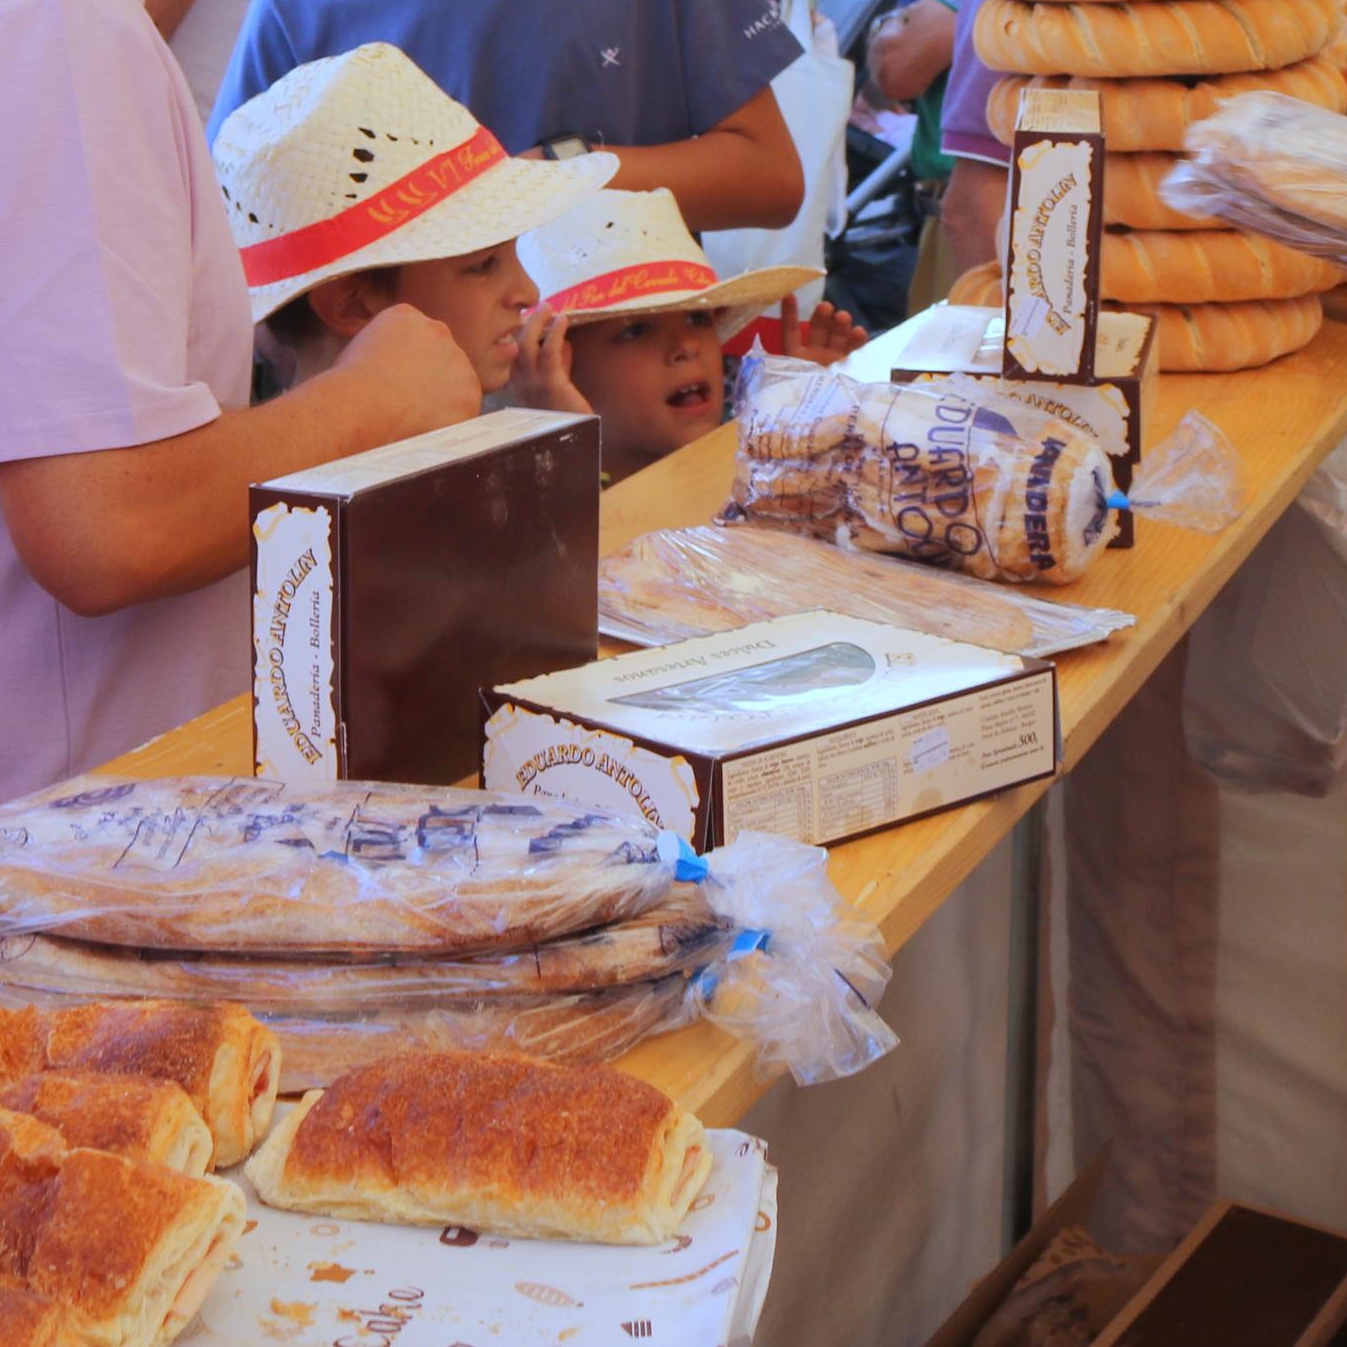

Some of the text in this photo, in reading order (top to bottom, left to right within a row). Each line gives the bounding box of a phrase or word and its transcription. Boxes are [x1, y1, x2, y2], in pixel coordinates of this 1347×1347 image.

[1026, 249, 1071, 336] EDARDO
[268, 647, 323, 766] EDUARDO
[516, 743, 595, 790] EDUARDO
